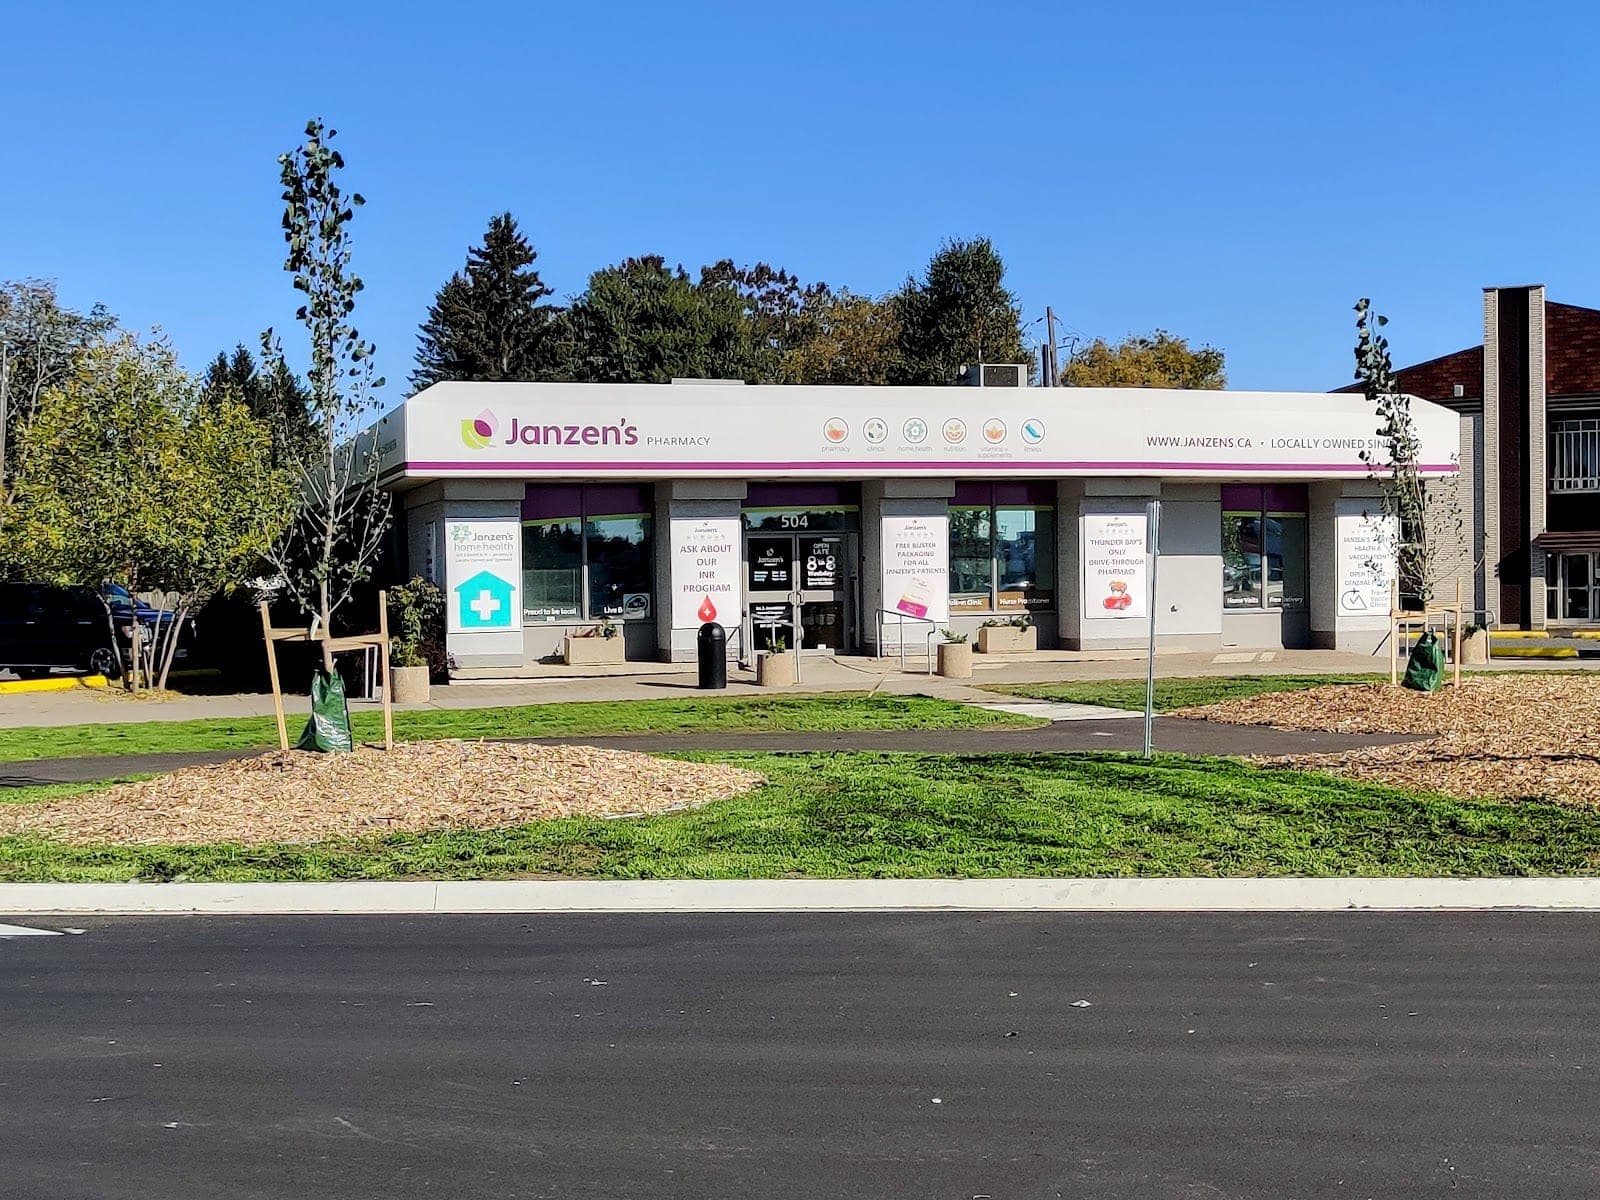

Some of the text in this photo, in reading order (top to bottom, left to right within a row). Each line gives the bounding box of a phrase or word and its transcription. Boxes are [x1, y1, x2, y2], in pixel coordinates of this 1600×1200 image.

[505, 418, 711, 446] Janzen's PHARMACY
[1146, 436, 1252, 448] WWW.JANZENS.CA
[1271, 438, 1319, 449] LOCALLY
[1322, 438, 1364, 449] OWNED
[781, 515, 809, 528] 504
[680, 544, 732, 553] ASK ABOUT
[696, 558, 717, 566] OUR
[699, 571, 715, 579] INR
[683, 584, 731, 592] PROGRAM
